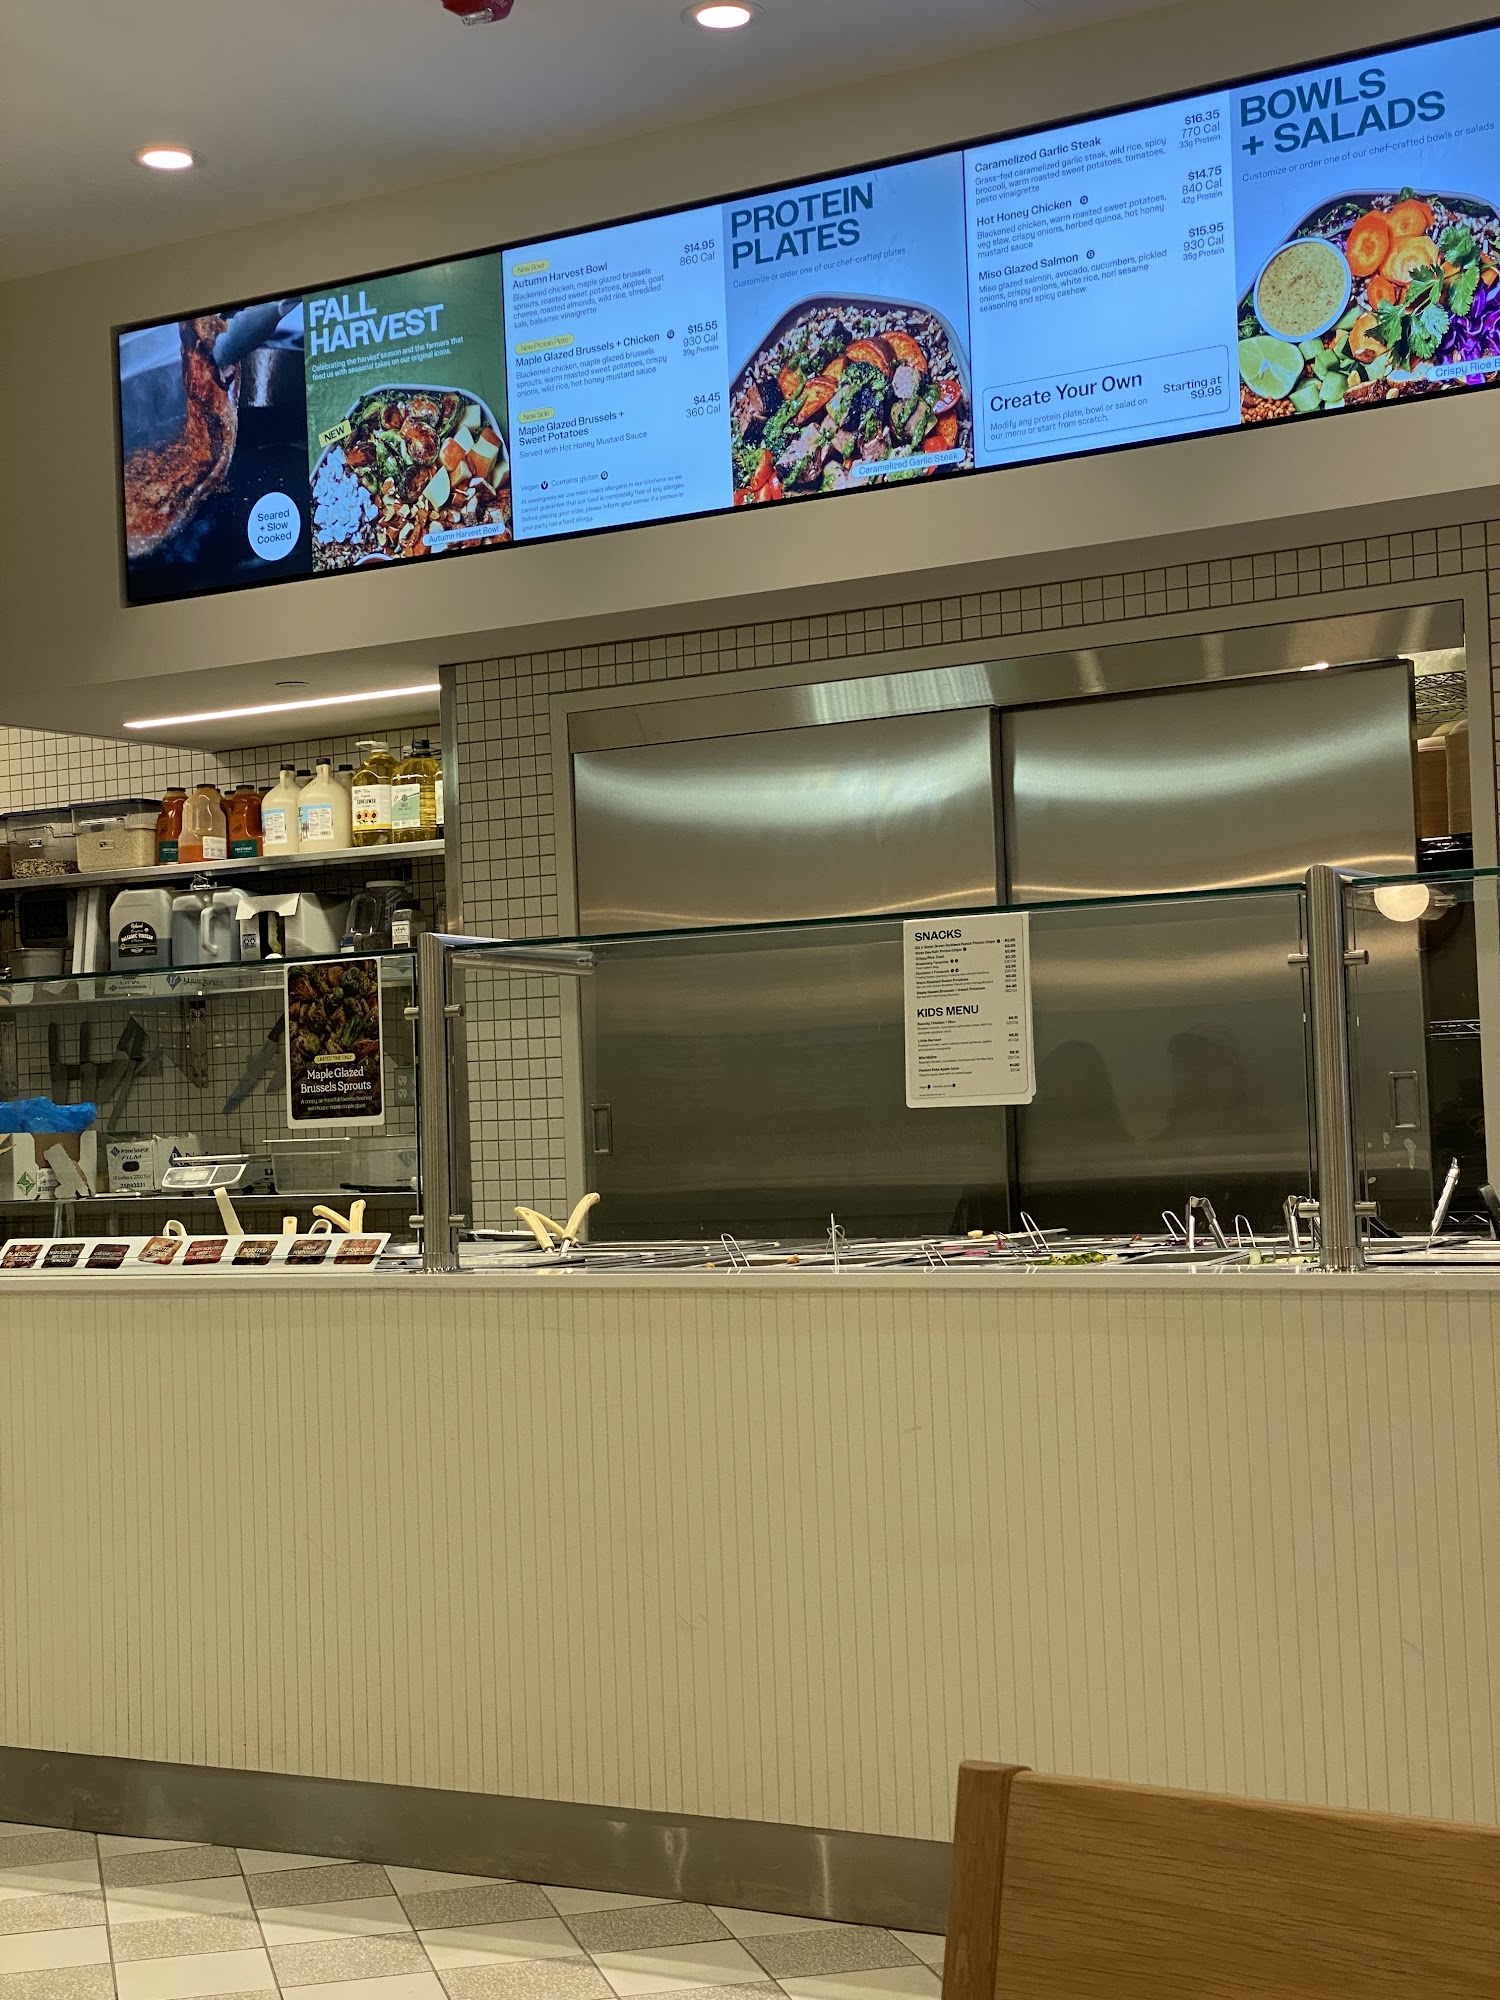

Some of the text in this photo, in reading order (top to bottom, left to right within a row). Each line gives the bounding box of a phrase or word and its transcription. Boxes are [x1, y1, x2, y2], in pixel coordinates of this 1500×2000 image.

[1240, 68, 1386, 127] BOWLS
[1185, 109, 1220, 125] $16.35
[1242, 91, 1445, 156] + SALADS
[1181, 122, 1220, 139] 770 Cal
[1179, 135, 1221, 149] 33g Protein
[975, 137, 1101, 172] Caramelized Garlic Steak
[1242, 168, 1287, 182] Customize
[1300, 160, 1322, 170] order
[1324, 156, 1340, 165] one
[1342, 152, 1350, 161] of
[1352, 150, 1367, 159] our
[1369, 136, 1425, 155] chef-crafted
[1427, 131, 1452, 143] bowls
[1466, 122, 1495, 135] salads
[975, 139, 1166, 186] Grass-fed caramelized garlic steak, wild rice, spicy
[1188, 165, 1222, 181] $14.75
[1182, 178, 1222, 195] 840 Cal
[1181, 191, 1223, 204] 42g Protein
[731, 182, 873, 238] PROTEIN
[977, 200, 1072, 227] Hot Honey Chicken
[1189, 222, 1224, 238] $15.95
[684, 239, 715, 254] $14.95
[732, 219, 860, 269] PLATES
[978, 242, 1033, 259] mustard sauce
[1184, 235, 1224, 251] 930 Cal
[680, 251, 715, 266] 860 Cal
[1183, 247, 1225, 261] 35g Protein
[531, 262, 545, 270] Bowl
[979, 254, 1078, 281] Miso Glazed Salmon
[979, 250, 1167, 294] Miso glazed salmon, avocado, cucumbers, pickled
[512, 262, 608, 290] Autumn Harvest Bowl
[513, 268, 652, 302] Blackened chicken, maple glazed brussels
[310, 291, 377, 327] FALL
[514, 308, 597, 328] kale, balsamic vinaigrette
[310, 304, 444, 356] HARVEST
[688, 320, 718, 335] $15.55
[683, 332, 718, 347] 930 Cal
[312, 361, 346, 373] Celebrating
[357, 352, 380, 363] harvest
[380, 350, 402, 359] season
[402, 346, 414, 354] and
[426, 340, 450, 349] farmers
[450, 336, 464, 345] that
[516, 355, 542, 367] Maple
[544, 348, 574, 362] Glazed
[576, 341, 614, 356] Brussels
[623, 334, 660, 347] Chicken
[696, 345, 719, 354] Protein
[1436, 366, 1467, 377] Crispy
[1470, 362, 1492, 372] Rice
[1163, 376, 1222, 393] Starting at
[1191, 386, 1222, 400] $9.95
[694, 392, 721, 405] $4.45
[991, 375, 1142, 412] Create Your Own
[686, 404, 721, 418] 360 Cal
[325, 425, 345, 442] NEW
[519, 425, 545, 439] Maple
[546, 418, 577, 431] Glazed
[578, 412, 617, 426] Brussels
[519, 429, 589, 446] Sweet Potatoes
[520, 448, 543, 459] Served
[544, 446, 558, 454] with
[573, 441, 595, 450] Honey
[596, 434, 624, 445] Mustard
[626, 432, 648, 441] Sauce
[859, 452, 958, 475] Caramelized Garlic Steak
[520, 482, 542, 492] Vegan
[551, 473, 602, 487] Contains gluten
[258, 509, 290, 522] Seared
[267, 522, 288, 532] Slow
[429, 525, 499, 543] Autumn Harvest Bowl
[257, 530, 292, 544] Cooked
[915, 929, 961, 941] SNACKS
[917, 1005, 979, 1017] KIDS MENU
[307, 1066, 364, 1081] Maple Glazed
[301, 1081, 371, 1093] Brussels Sprouts
